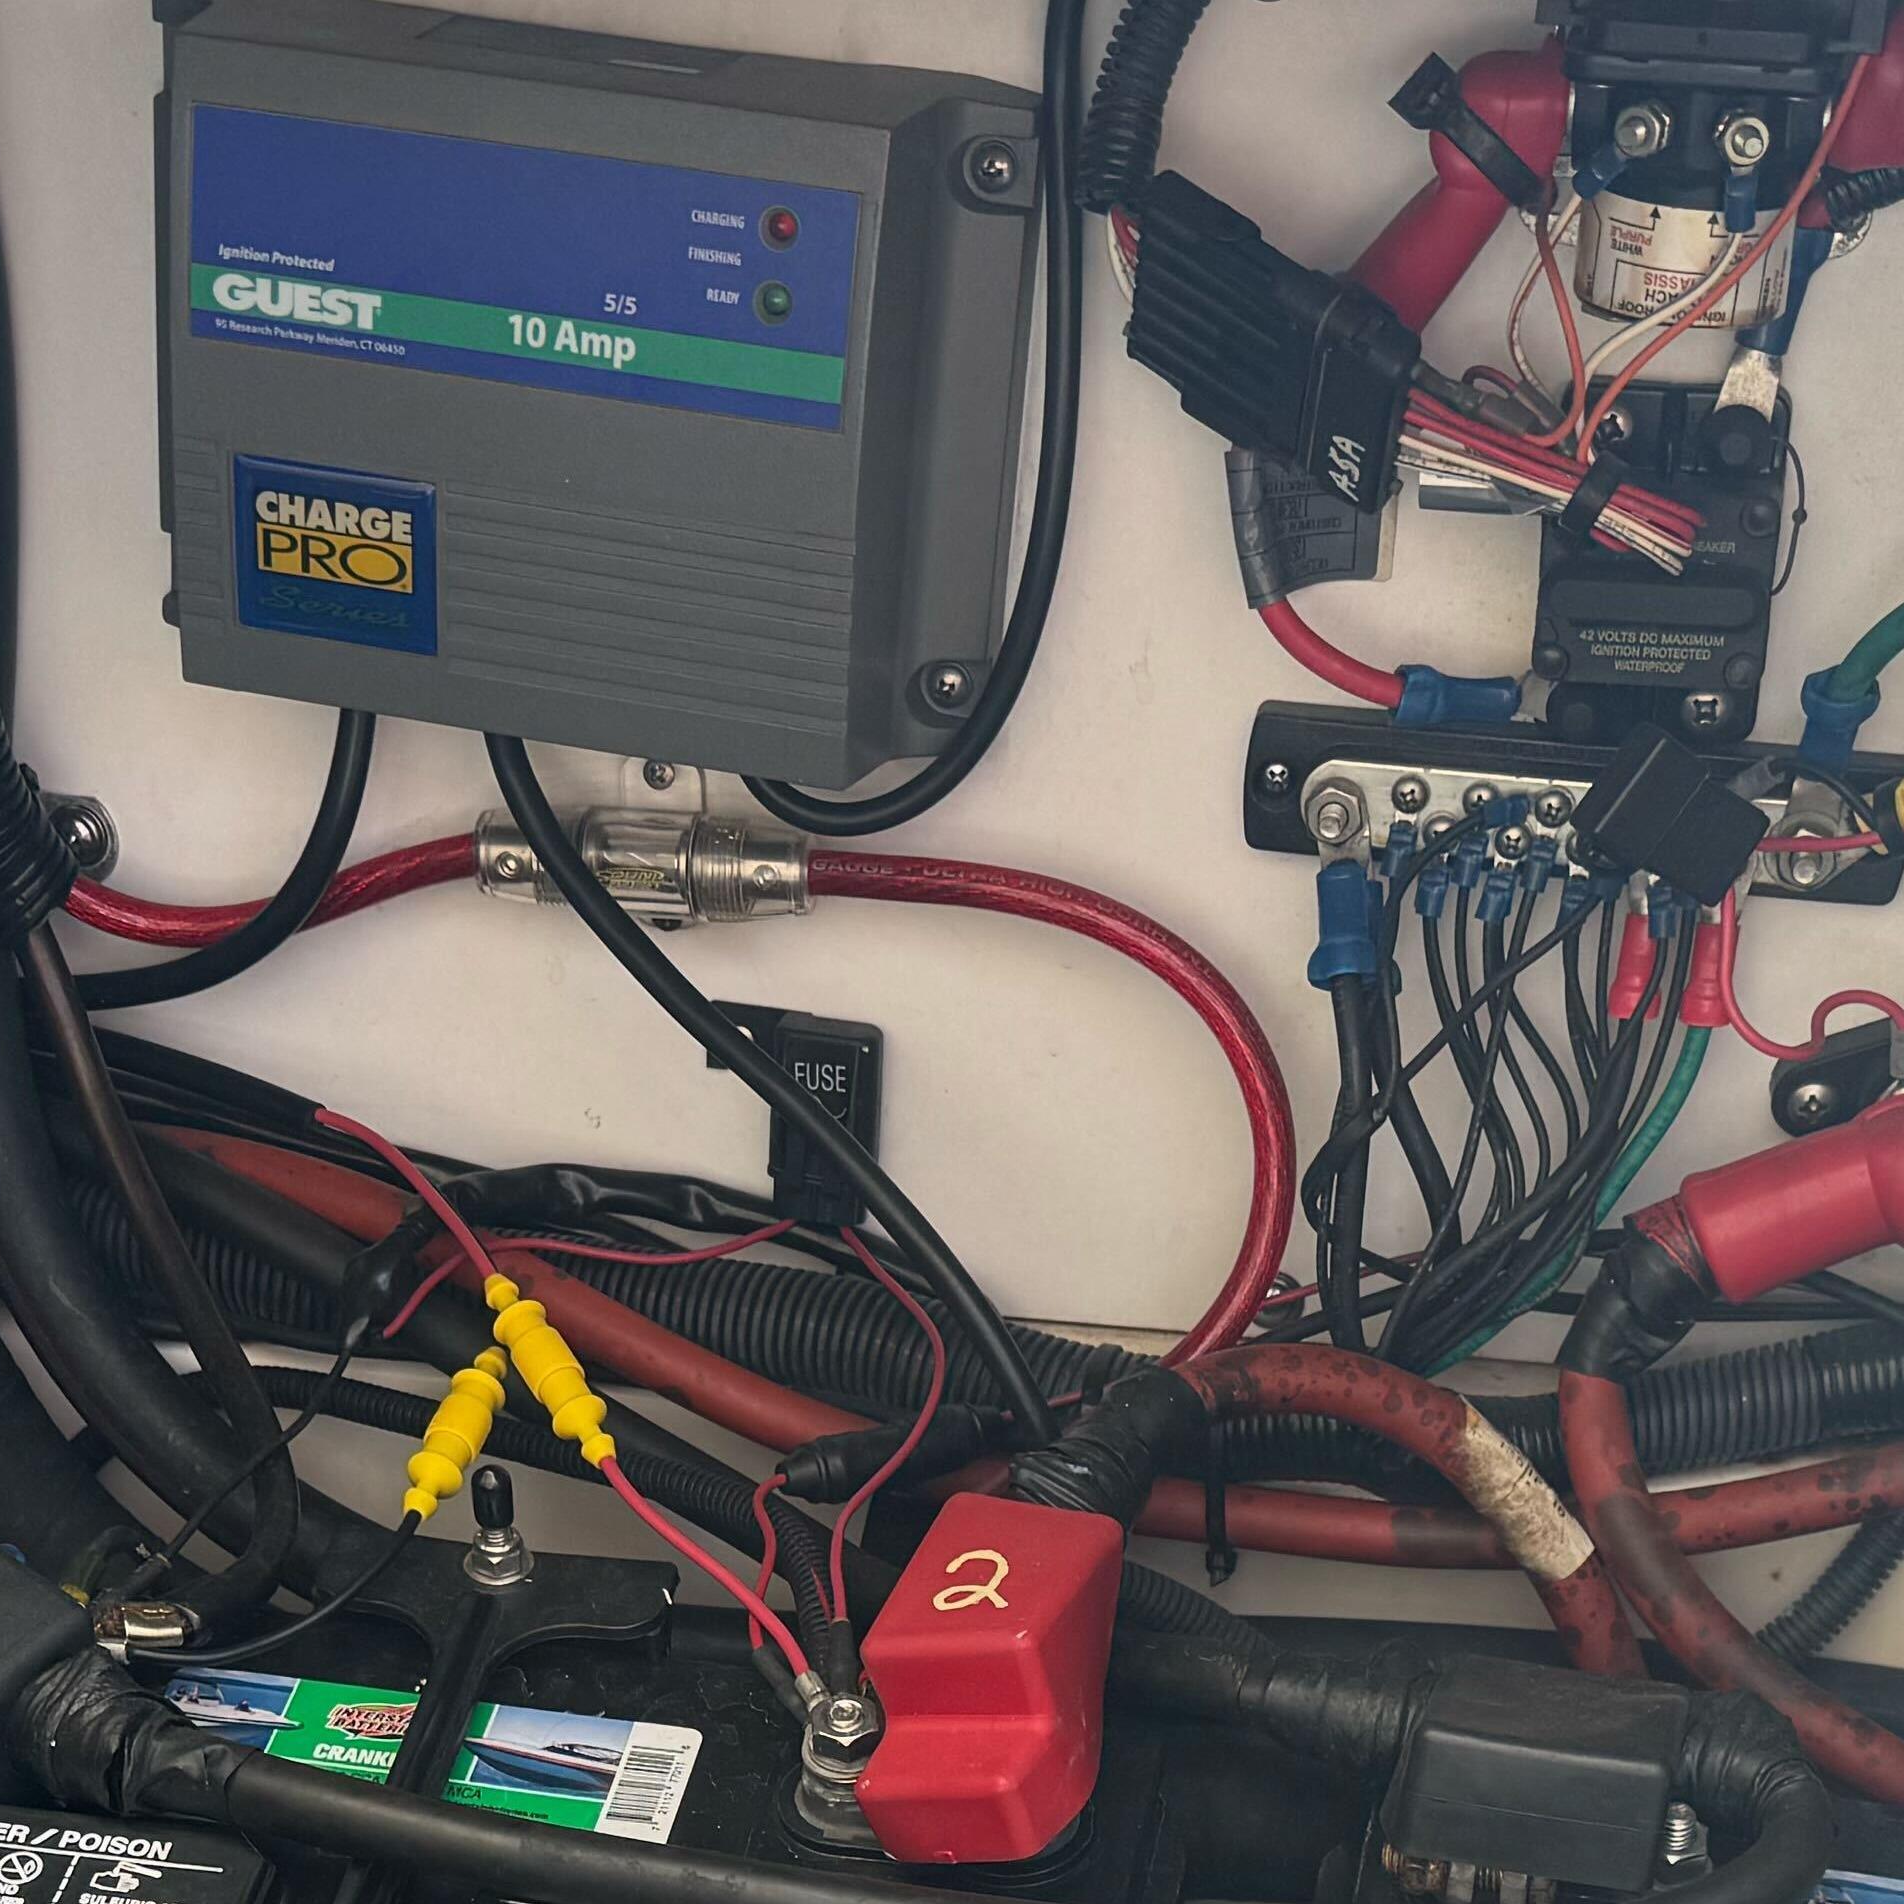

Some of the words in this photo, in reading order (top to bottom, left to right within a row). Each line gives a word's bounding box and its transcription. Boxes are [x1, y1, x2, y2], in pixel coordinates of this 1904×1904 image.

[691, 209, 745, 229] CHARGING
[1609, 224, 1654, 248] PURPLE
[1610, 237, 1644, 257] WHITE
[218, 243, 270, 262] Ignition
[271, 250, 336, 272] Protected
[688, 246, 742, 266] FINISHING
[212, 272, 382, 331] GUEST
[603, 293, 638, 316] 5/5
[706, 288, 740, 305] READY
[229, 319, 273, 337] Research
[508, 313, 547, 348] 10
[553, 320, 637, 369] Amp
[255, 490, 413, 545] CHARGE
[262, 527, 408, 586] PRO
[1597, 630, 1636, 645] VOLTS
[1661, 633, 1725, 647] MAXIMUM
[1591, 643, 1640, 658] IGNITION
[1643, 646, 1711, 661] PROTECTED
[1614, 659, 1685, 674] WATERPROOF
[812, 857, 894, 876] GAUGE
[794, 1062, 846, 1093] FUSE
[932, 1549, 1011, 1613] 2
[58, 1830, 173, 1861] POISON
